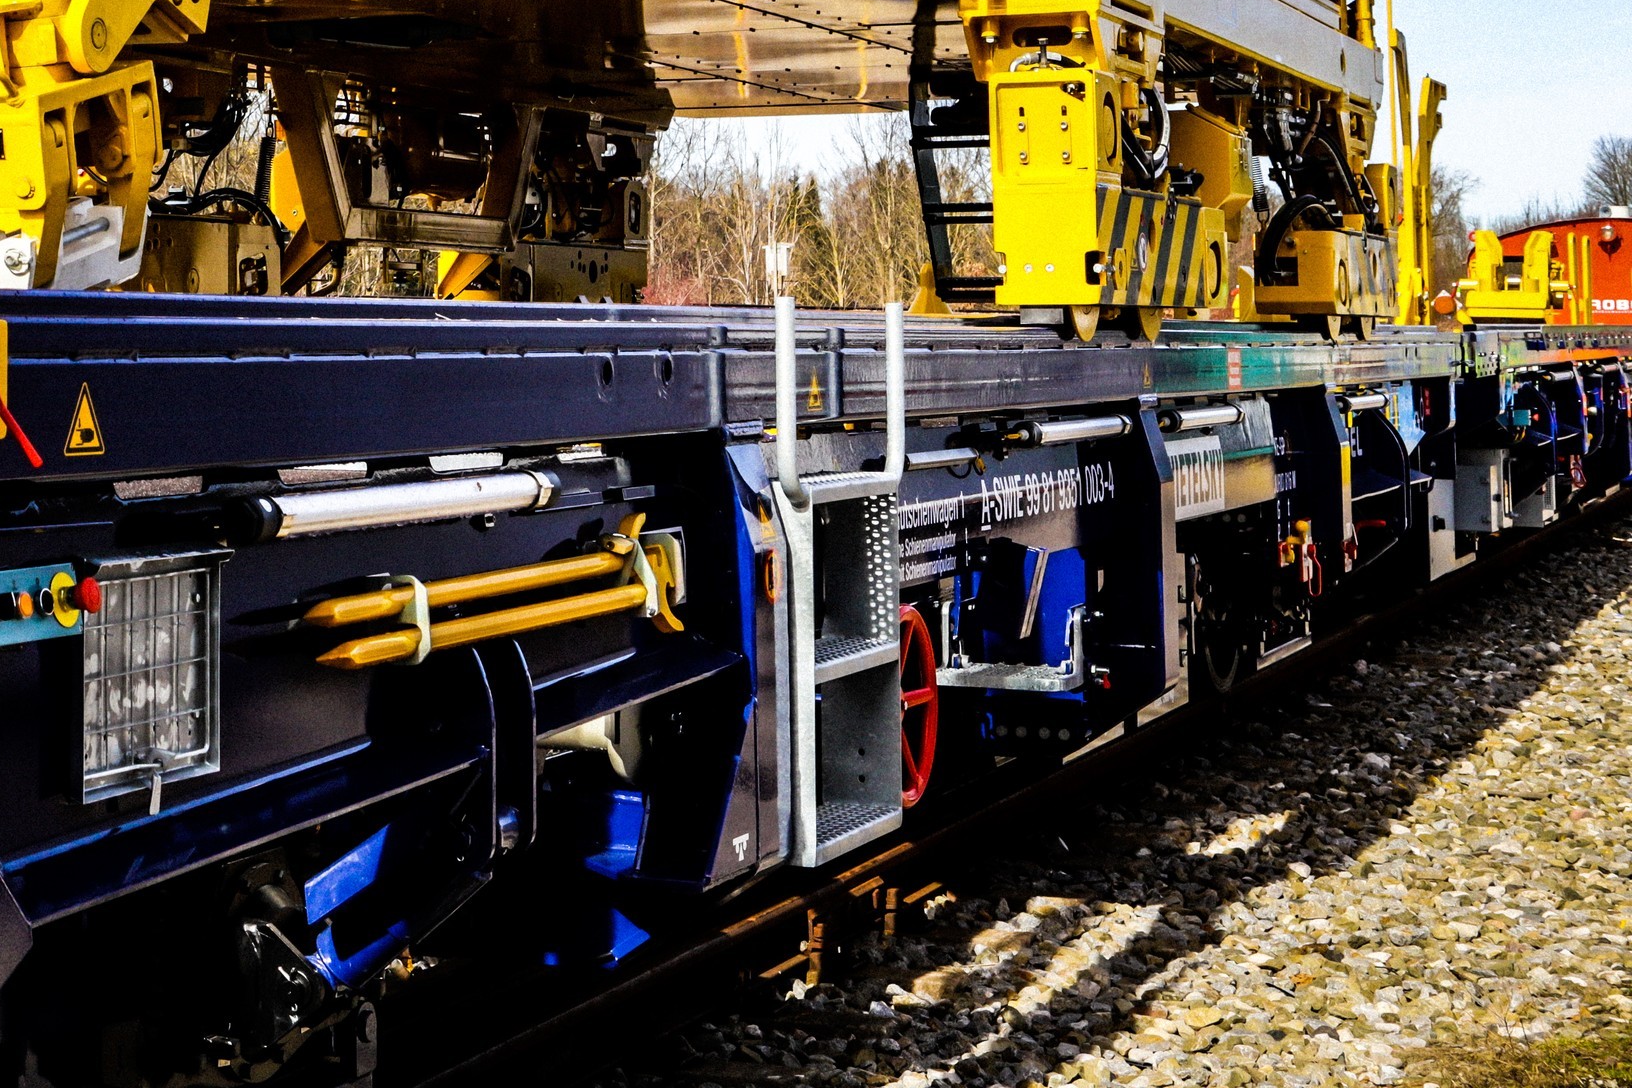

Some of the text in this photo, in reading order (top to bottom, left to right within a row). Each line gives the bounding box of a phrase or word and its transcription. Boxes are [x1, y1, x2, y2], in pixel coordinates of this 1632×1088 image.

[1591, 299, 1632, 311] ROB
[980, 461, 1115, 524] A-SWIE 99 81 9351 003-4
[898, 496, 959, 530] utschenwagen
[904, 530, 957, 557] Schienenmanipulator
[905, 554, 957, 581] Schienenmanipulator
